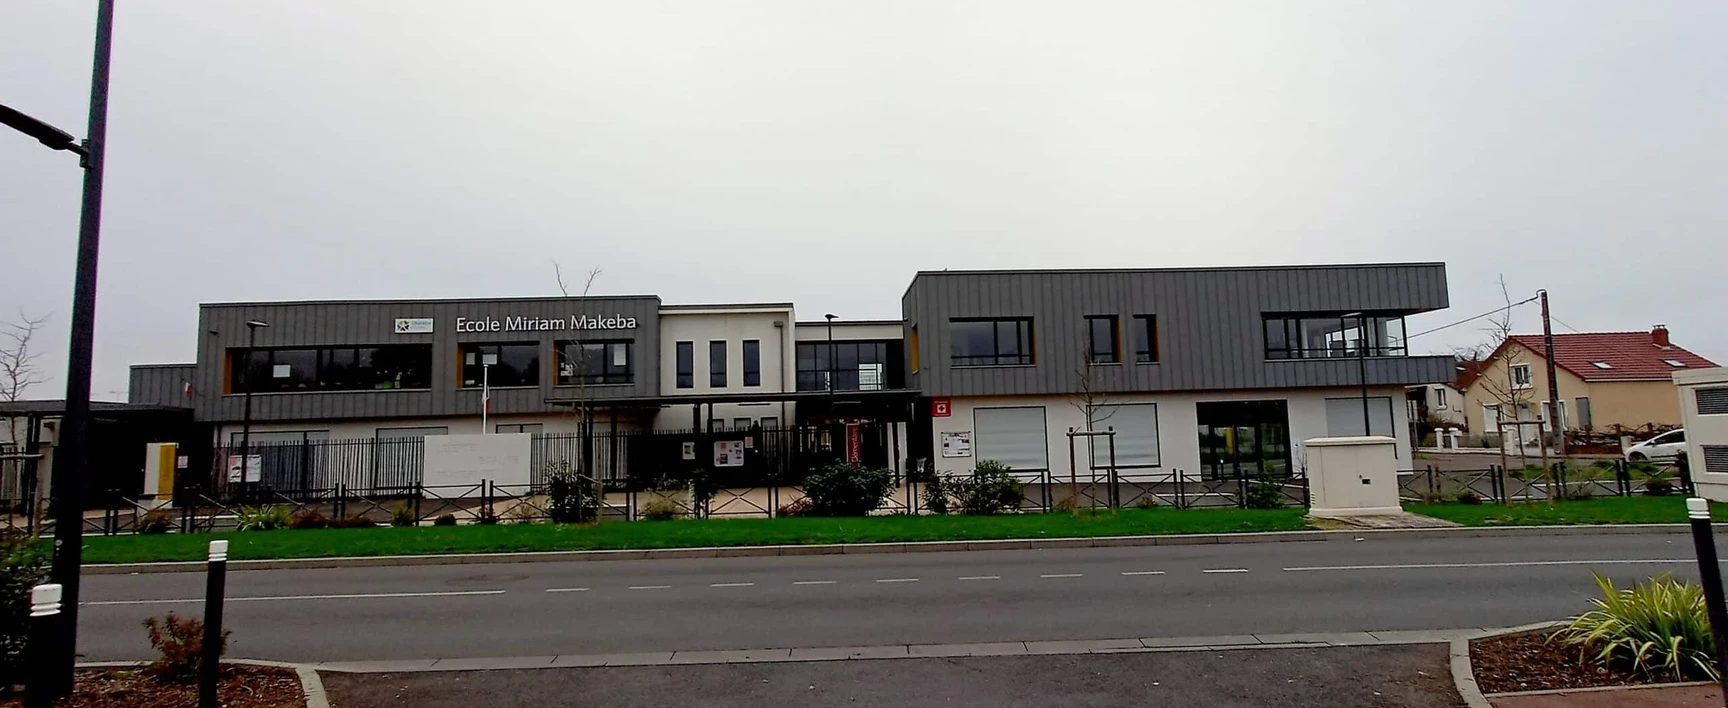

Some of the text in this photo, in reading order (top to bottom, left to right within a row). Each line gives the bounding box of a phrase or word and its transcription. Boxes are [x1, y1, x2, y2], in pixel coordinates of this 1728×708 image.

[456, 314, 636, 332] Ecole Miriam Makeba
